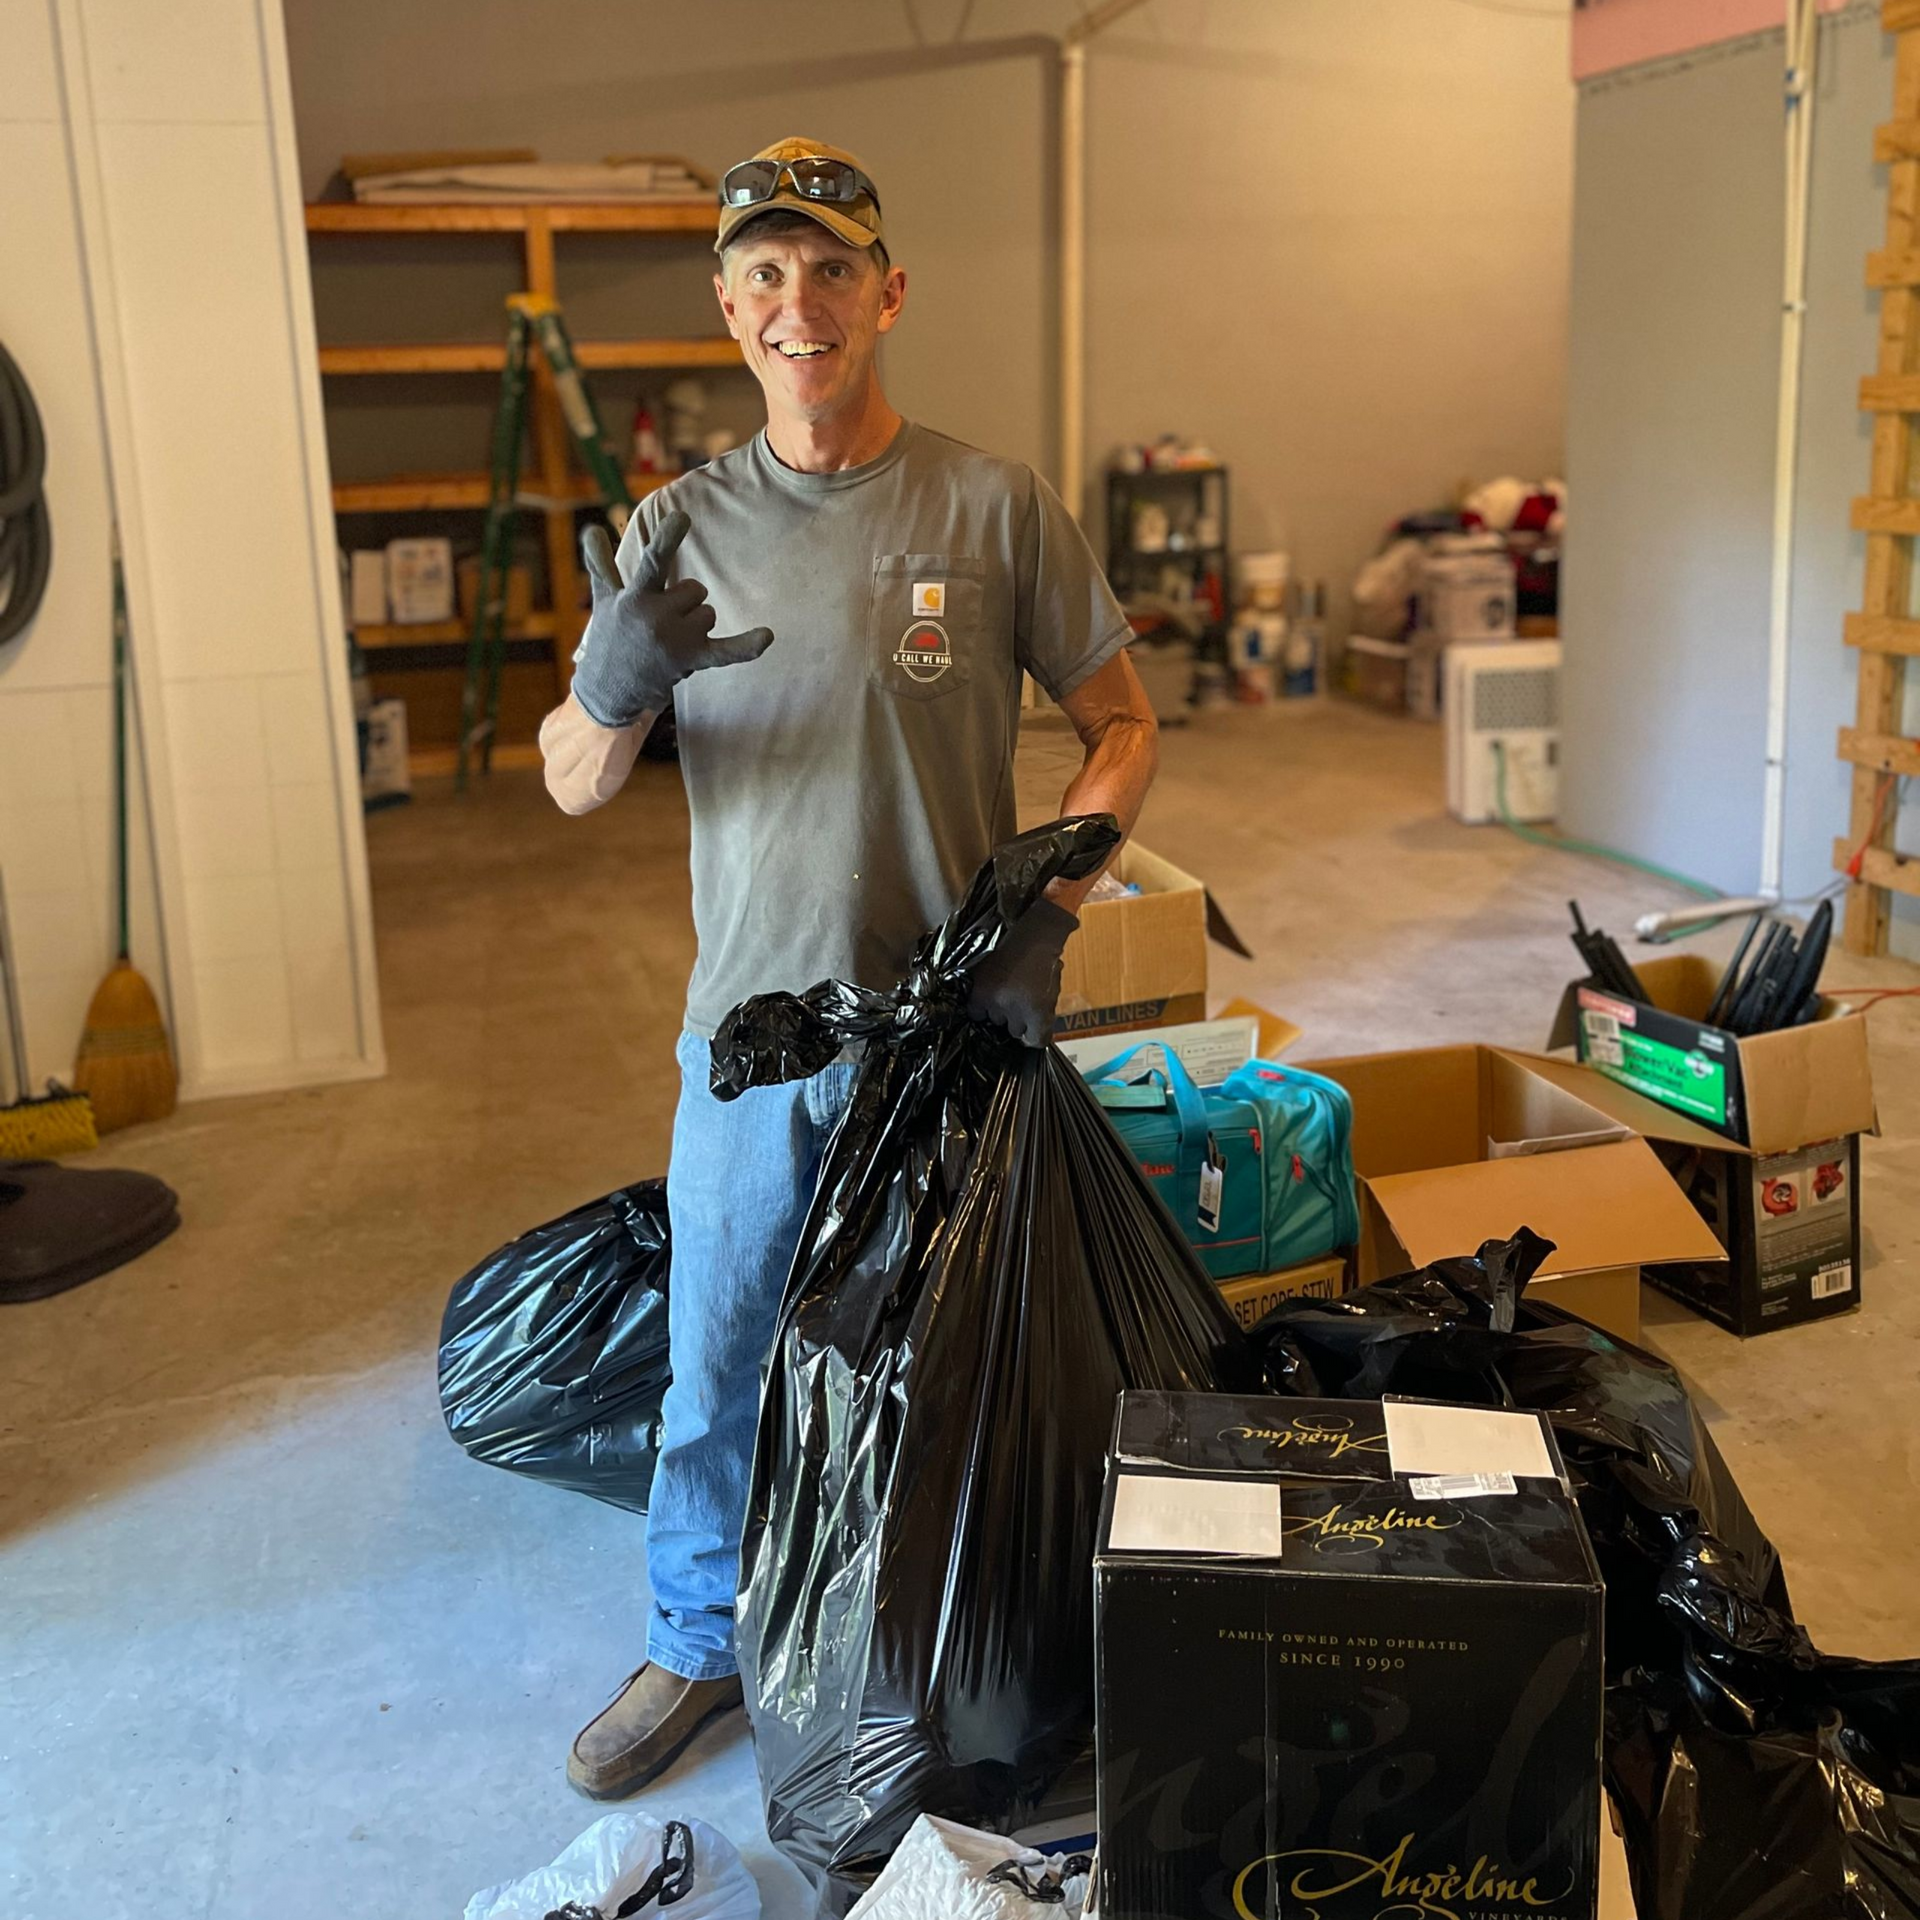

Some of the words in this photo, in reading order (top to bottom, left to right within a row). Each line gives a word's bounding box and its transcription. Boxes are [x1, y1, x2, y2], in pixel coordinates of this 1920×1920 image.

[893, 653, 898, 662] U
[901, 654, 919, 663] CALL
[922, 655, 933, 664] WE
[935, 656, 952, 665] HAUL
[1063, 1010, 1100, 1030] VAN
[1104, 1001, 1159, 1024] LINES
[1234, 1298, 1257, 1325] SET
[1301, 1277, 1334, 1299] STTW
[1218, 1628, 1275, 1643] FAMILY
[1282, 1633, 1339, 1645] OWNED
[1346, 1636, 1378, 1647] AND
[1386, 1638, 1469, 1652] OPERATED
[1279, 1652, 1341, 1666] SINCE
[1354, 1656, 1405, 1671] 1990
